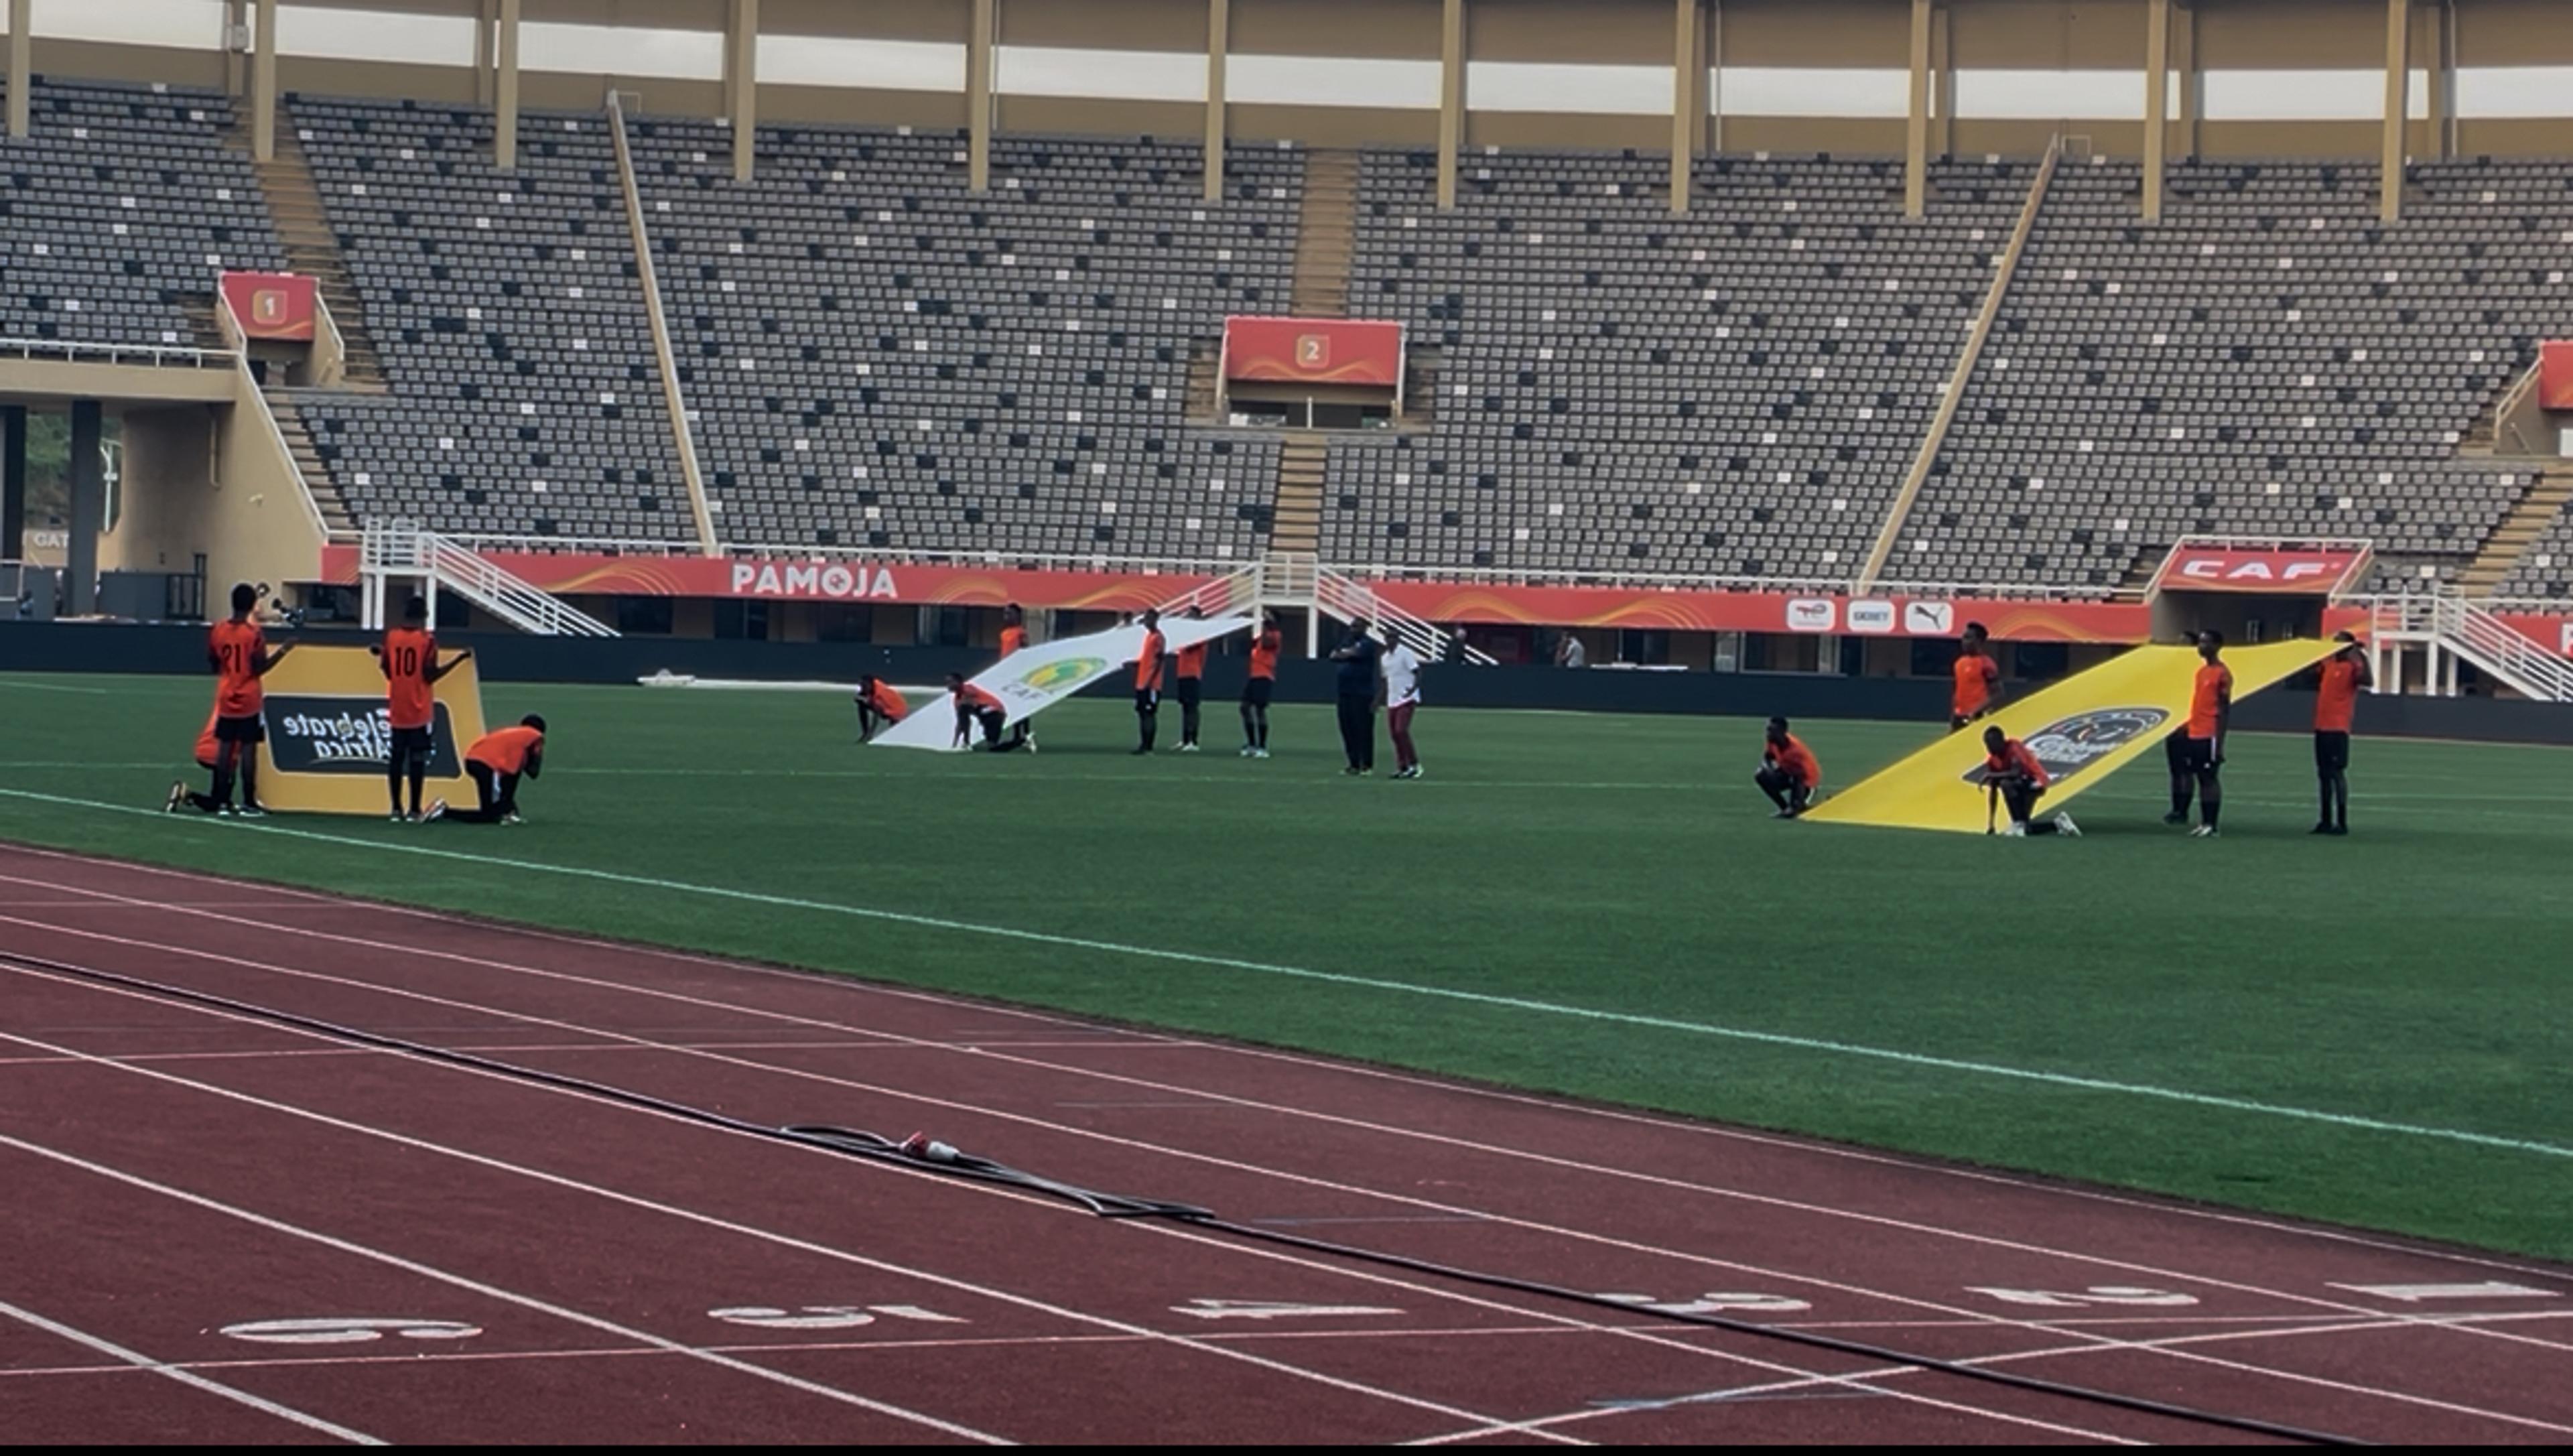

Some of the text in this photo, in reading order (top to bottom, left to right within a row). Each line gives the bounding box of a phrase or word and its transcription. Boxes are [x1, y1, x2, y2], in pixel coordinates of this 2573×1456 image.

[266, 297, 274, 316] 1
[1306, 341, 1319, 360] 2
[732, 563, 898, 598] PAMOJA
[2183, 560, 2326, 580] CAF
[396, 647, 416, 677] 10
[707, 1305, 973, 1329] 5
[218, 1318, 484, 1343] 6
